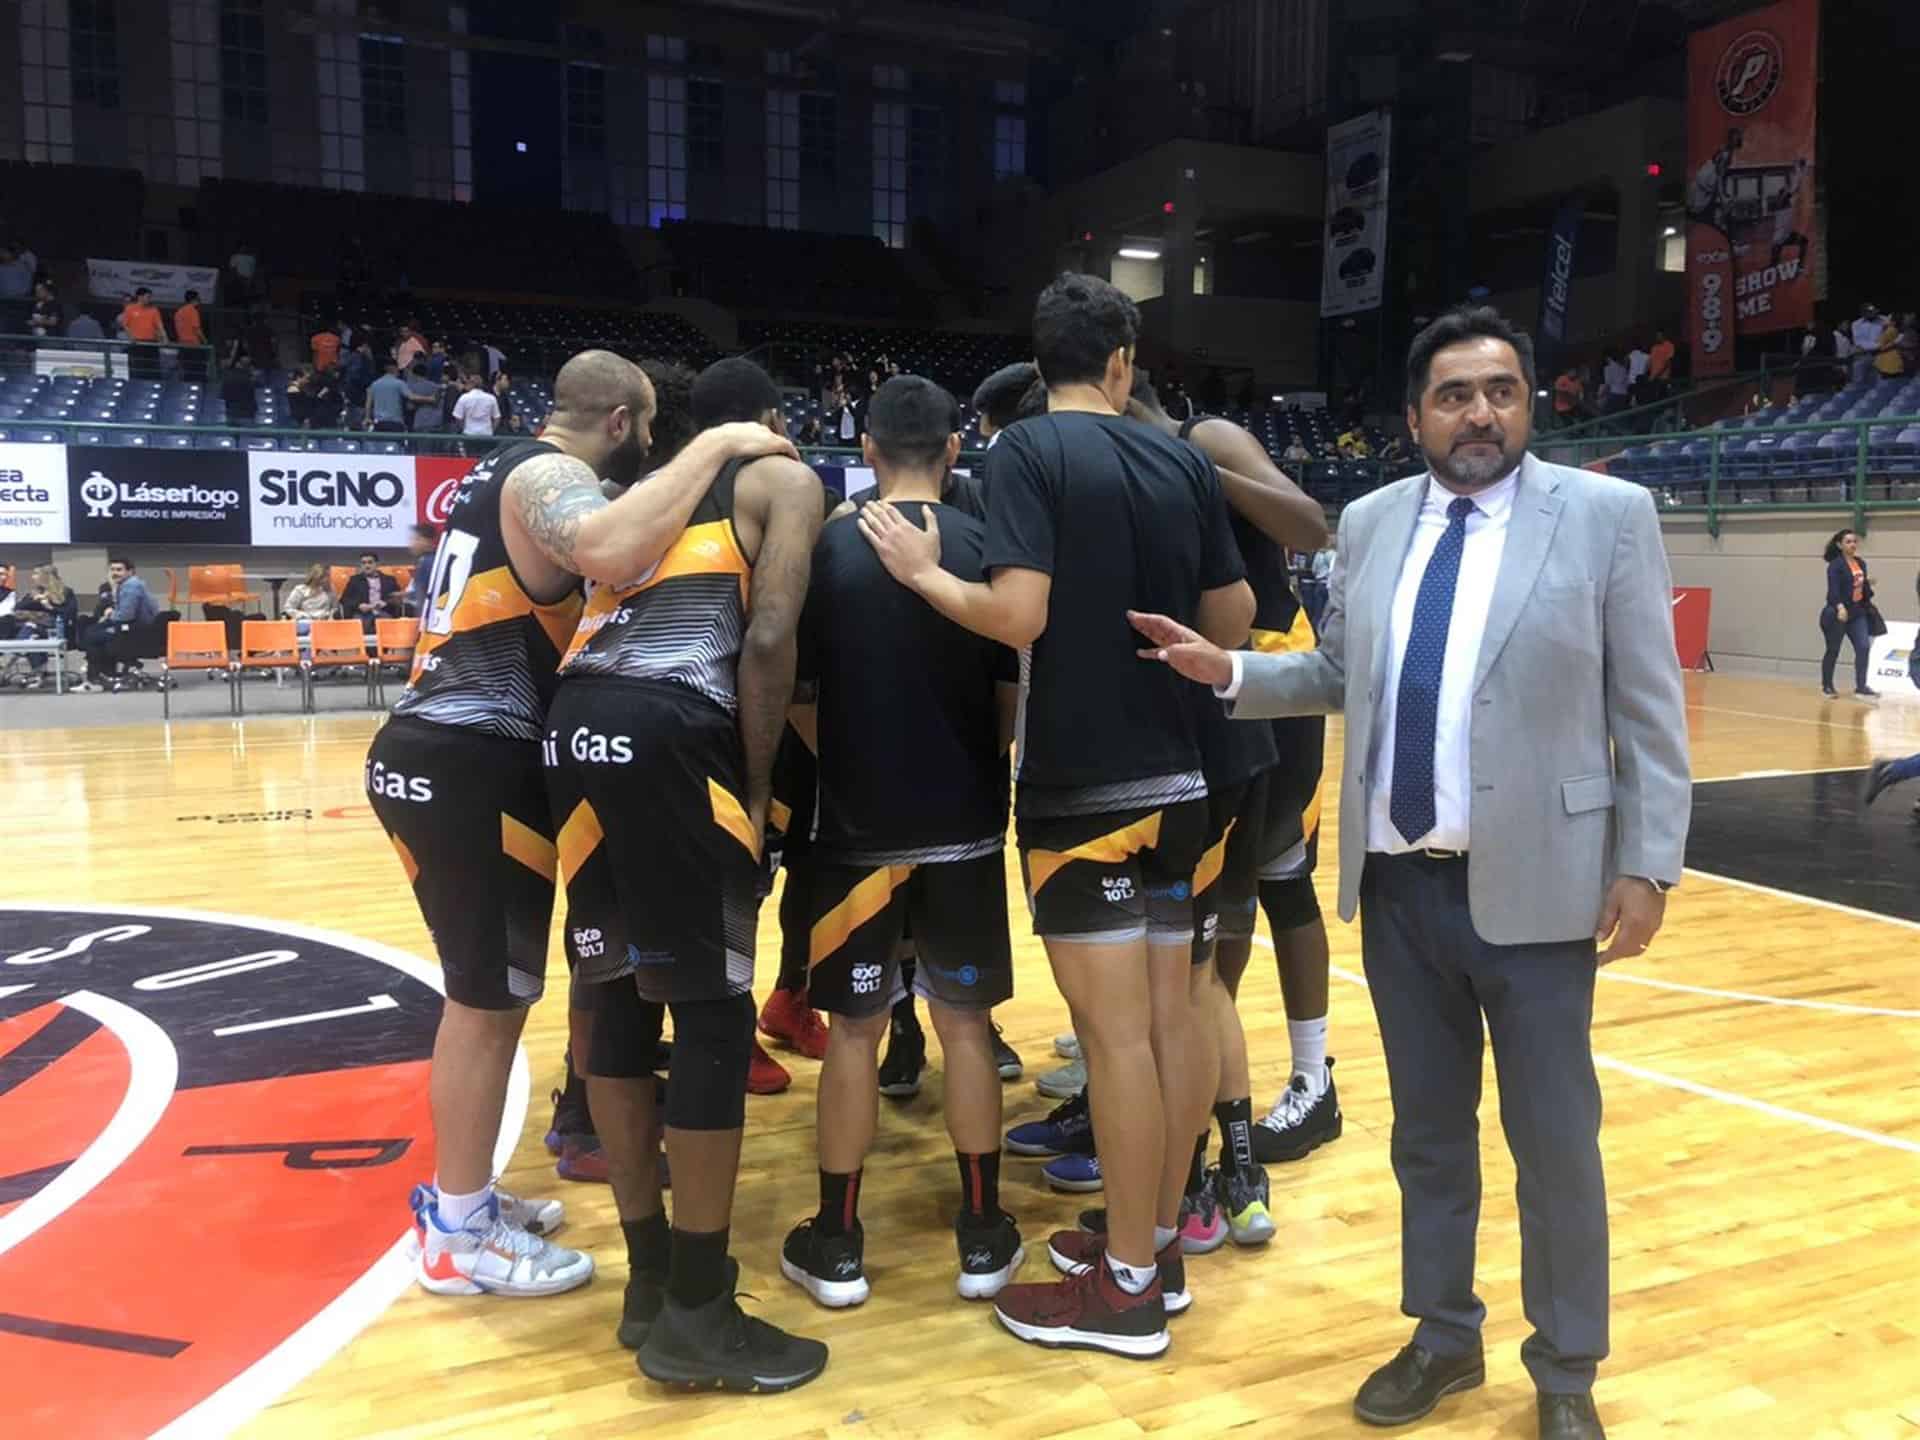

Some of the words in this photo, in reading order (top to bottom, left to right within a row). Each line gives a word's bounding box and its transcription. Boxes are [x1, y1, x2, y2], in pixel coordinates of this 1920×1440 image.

[1548, 233, 1573, 311] telcel
[1736, 294, 1772, 319] ME
[120, 481, 239, 509] Láserlogo
[259, 469, 404, 508] SiGNO
[121, 507, 161, 519] DISEÑO
[162, 509, 169, 519] E
[171, 508, 226, 520] IMPRESIÓN
[273, 512, 393, 530] multifuncional
[571, 726, 633, 764] Gas
[372, 761, 433, 802] Gas
